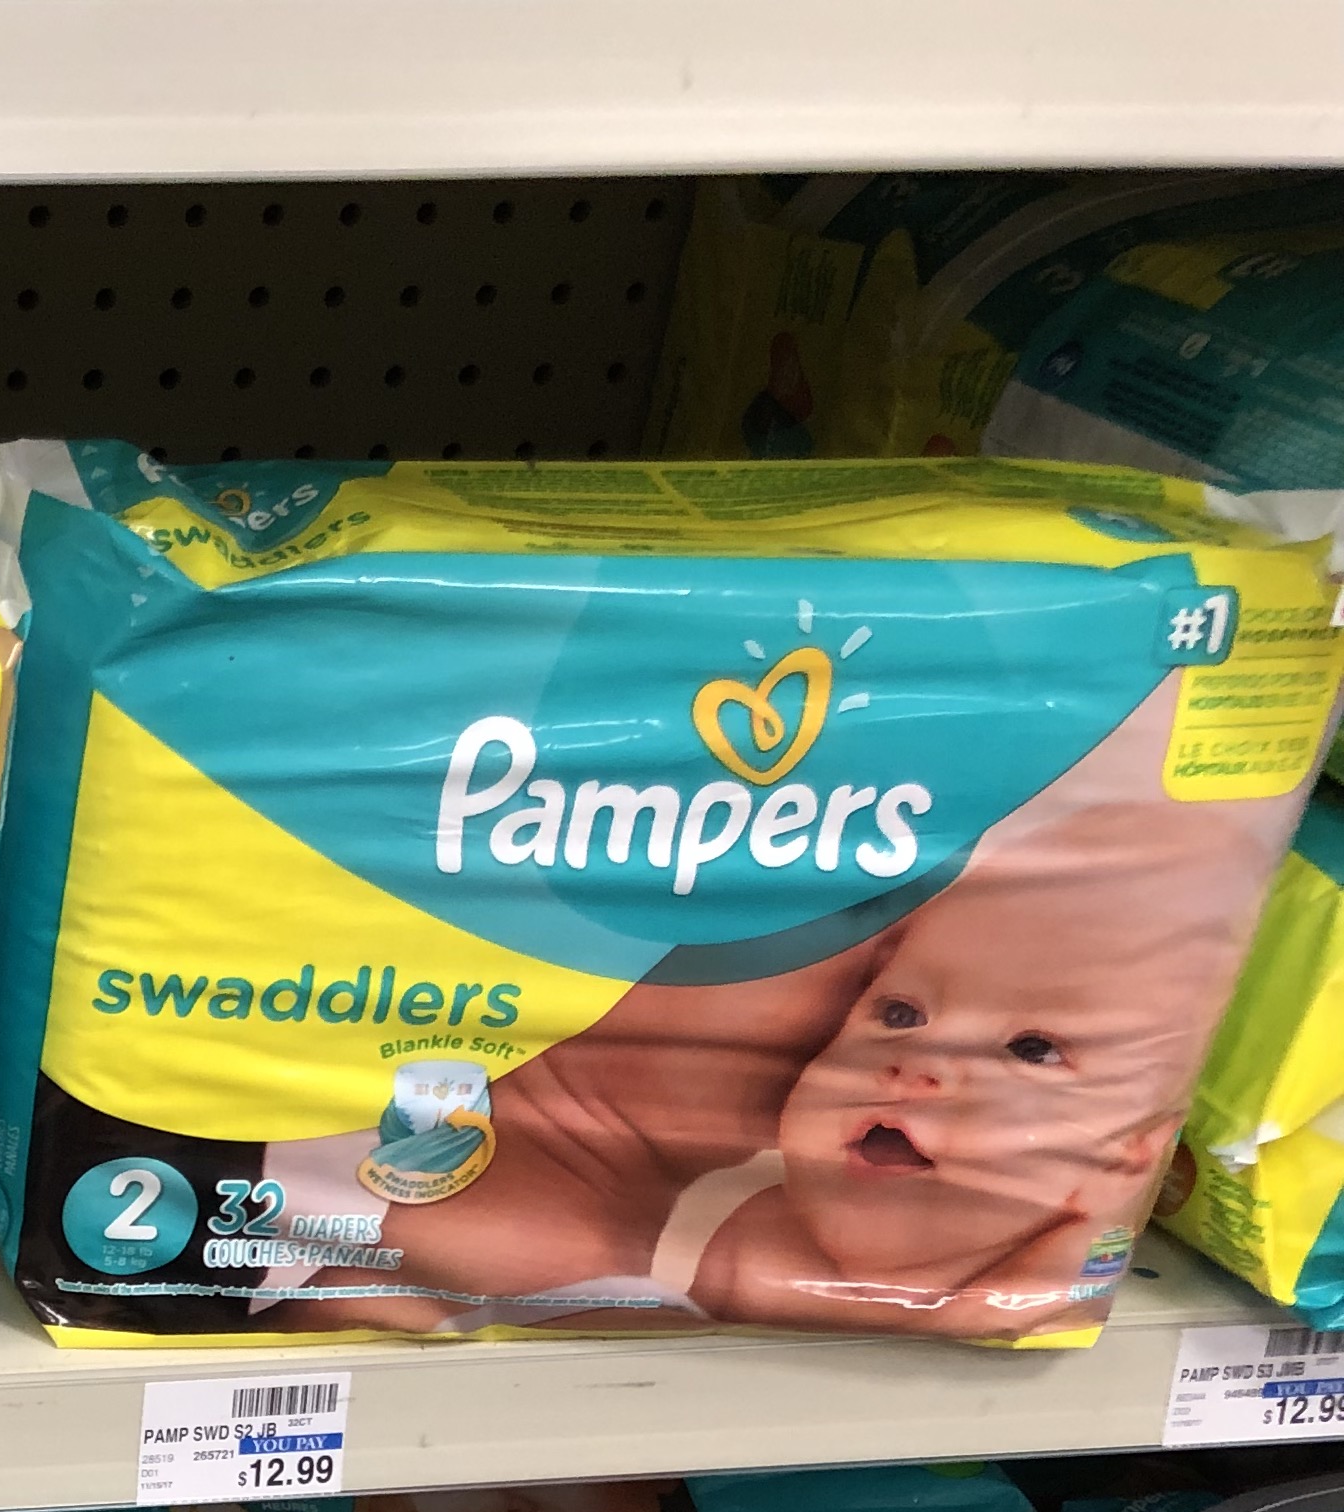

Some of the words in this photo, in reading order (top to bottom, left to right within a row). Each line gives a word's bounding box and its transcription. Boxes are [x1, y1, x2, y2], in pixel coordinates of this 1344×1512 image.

[1168, 593, 1230, 654] #1
[435, 715, 932, 897] Pampers
[91, 964, 523, 1028] swaddlers
[104, 1168, 163, 1242] 2
[207, 1180, 287, 1238] 32
[290, 1215, 382, 1244] DIAPERS
[143, 1427, 189, 1445] PAMP
[193, 1424, 230, 1442] SWD
[238, 1455, 334, 1489] $12.99
